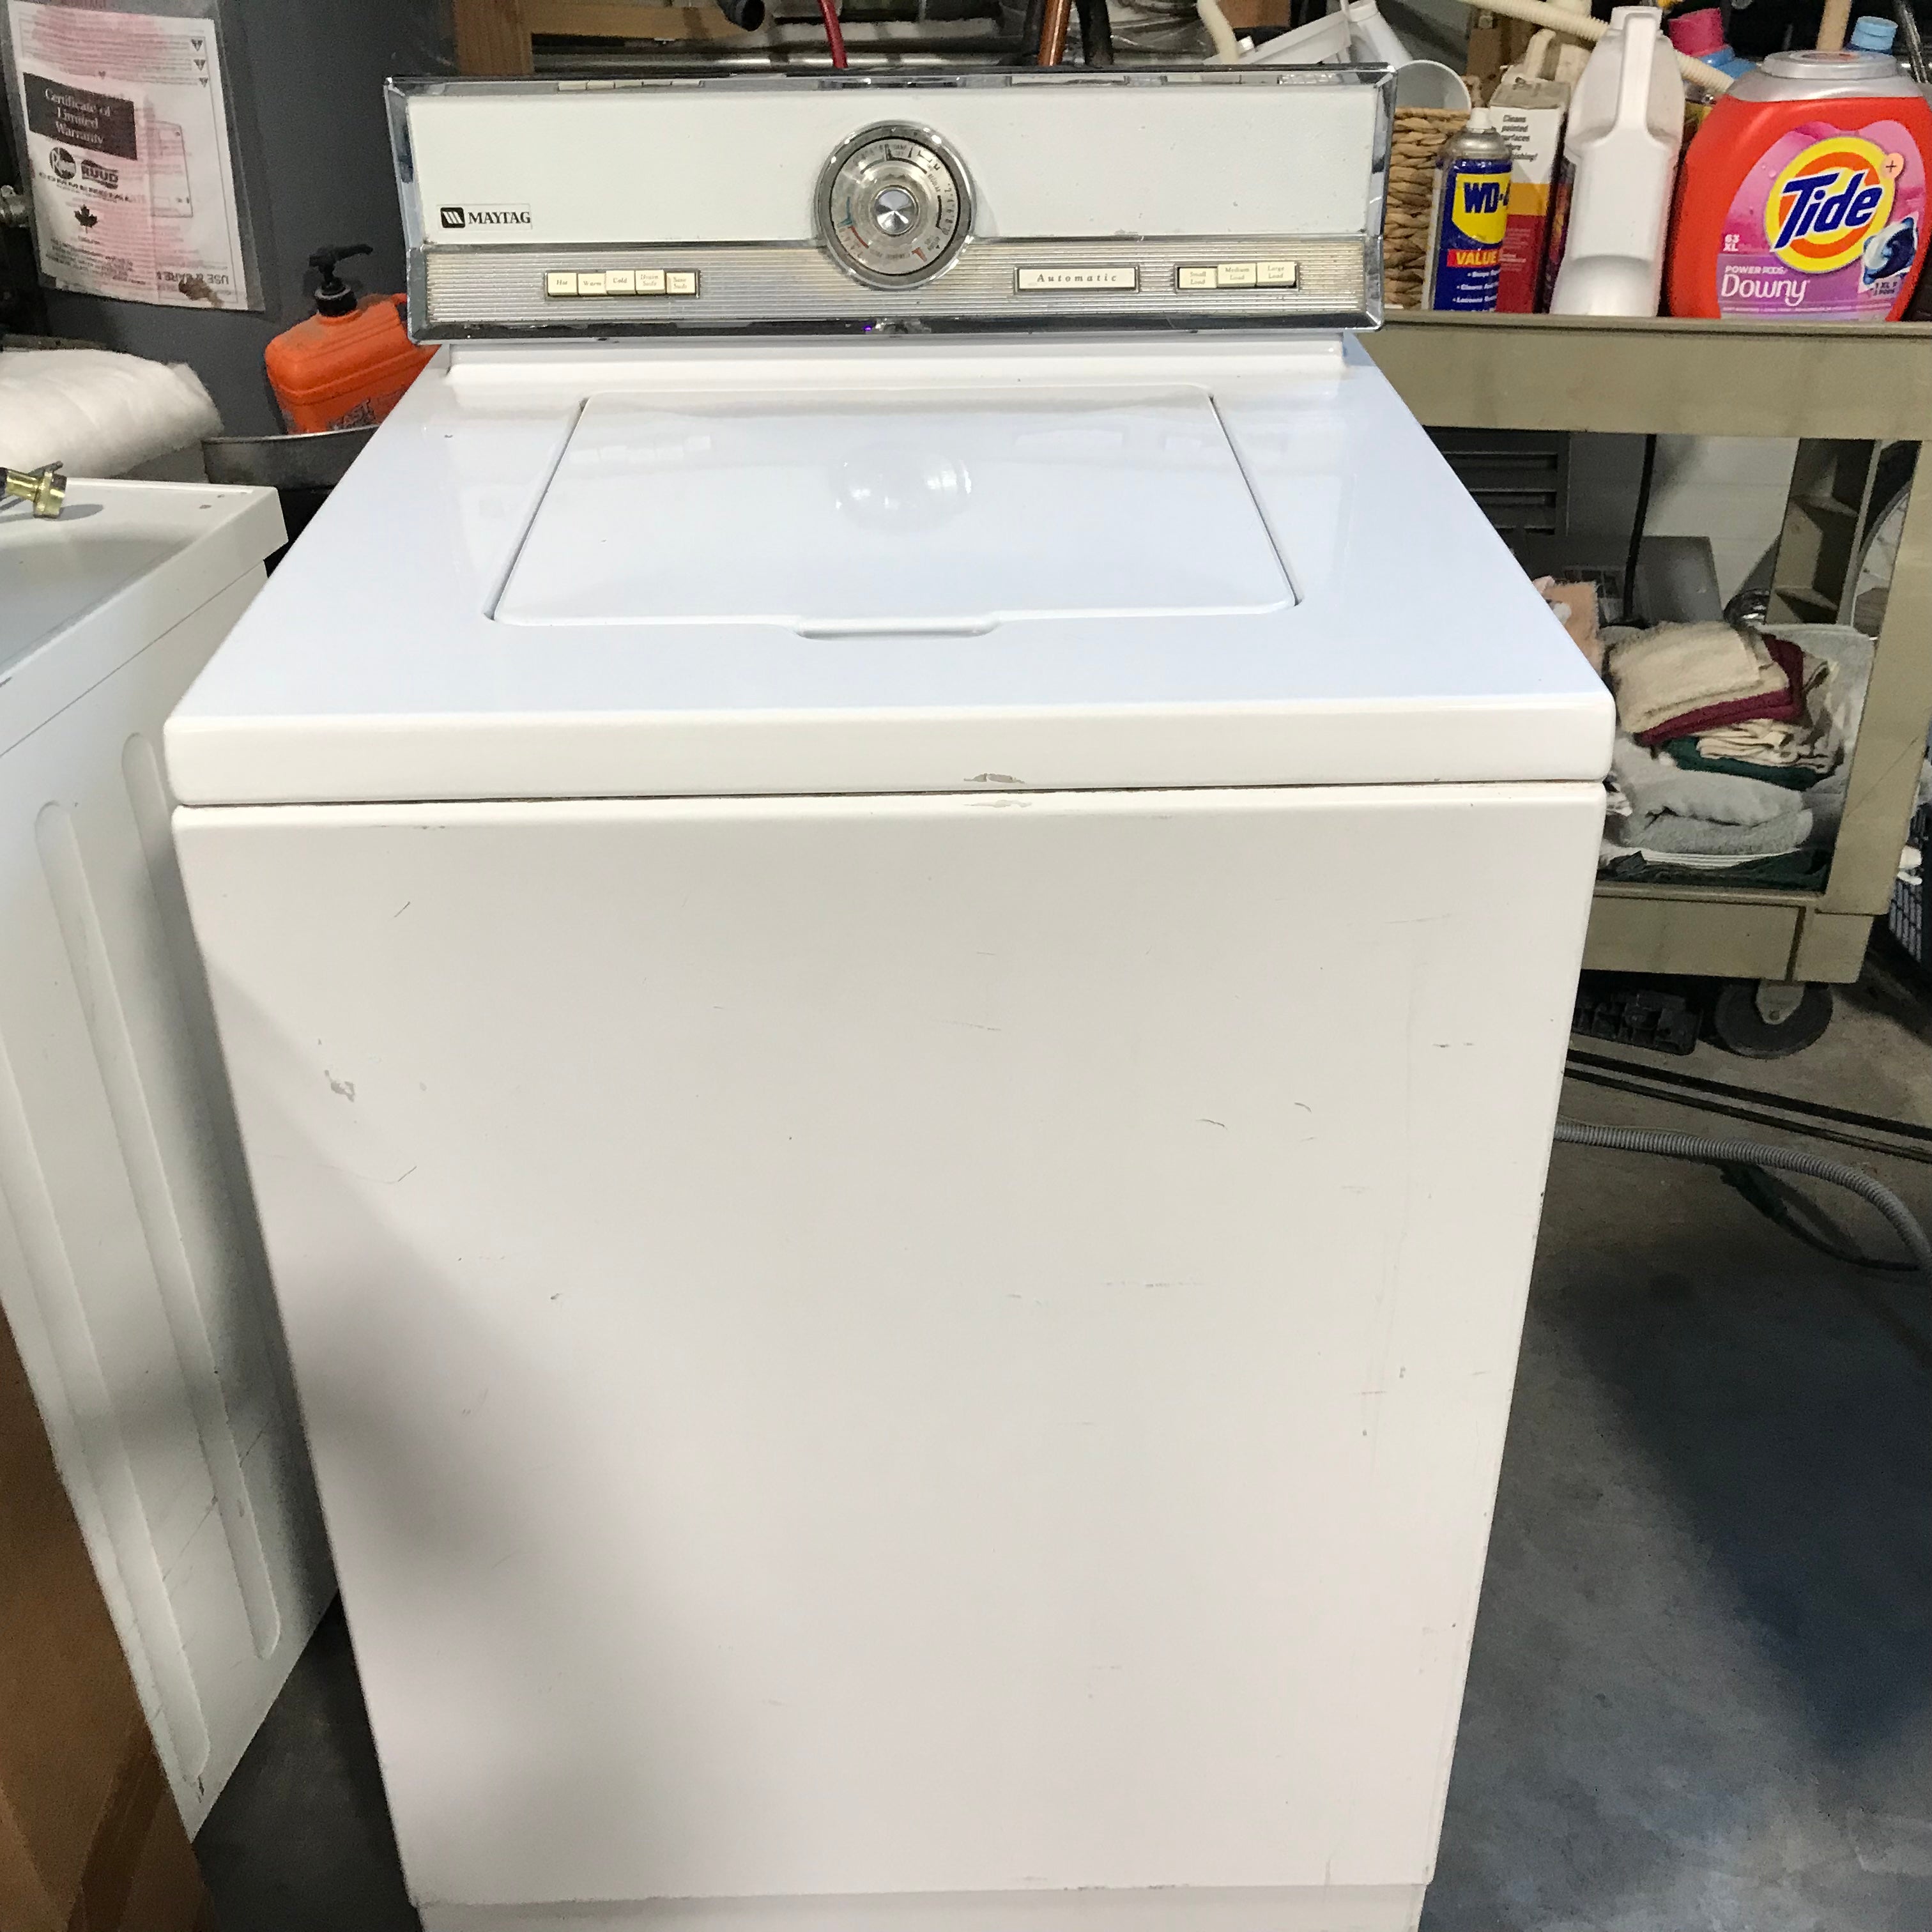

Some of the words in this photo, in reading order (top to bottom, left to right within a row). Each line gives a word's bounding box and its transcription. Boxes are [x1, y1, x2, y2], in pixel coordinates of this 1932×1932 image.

[56, 120, 104, 145] Warranty
[468, 211, 531, 224] MAYTAG
[1772, 171, 1883, 250] Tide
[1723, 243, 1738, 252] XL
[1455, 250, 1498, 266] VALUE
[1725, 265, 1761, 274] POWER
[1036, 273, 1117, 282] Automatic
[1721, 273, 1807, 307] Downy
